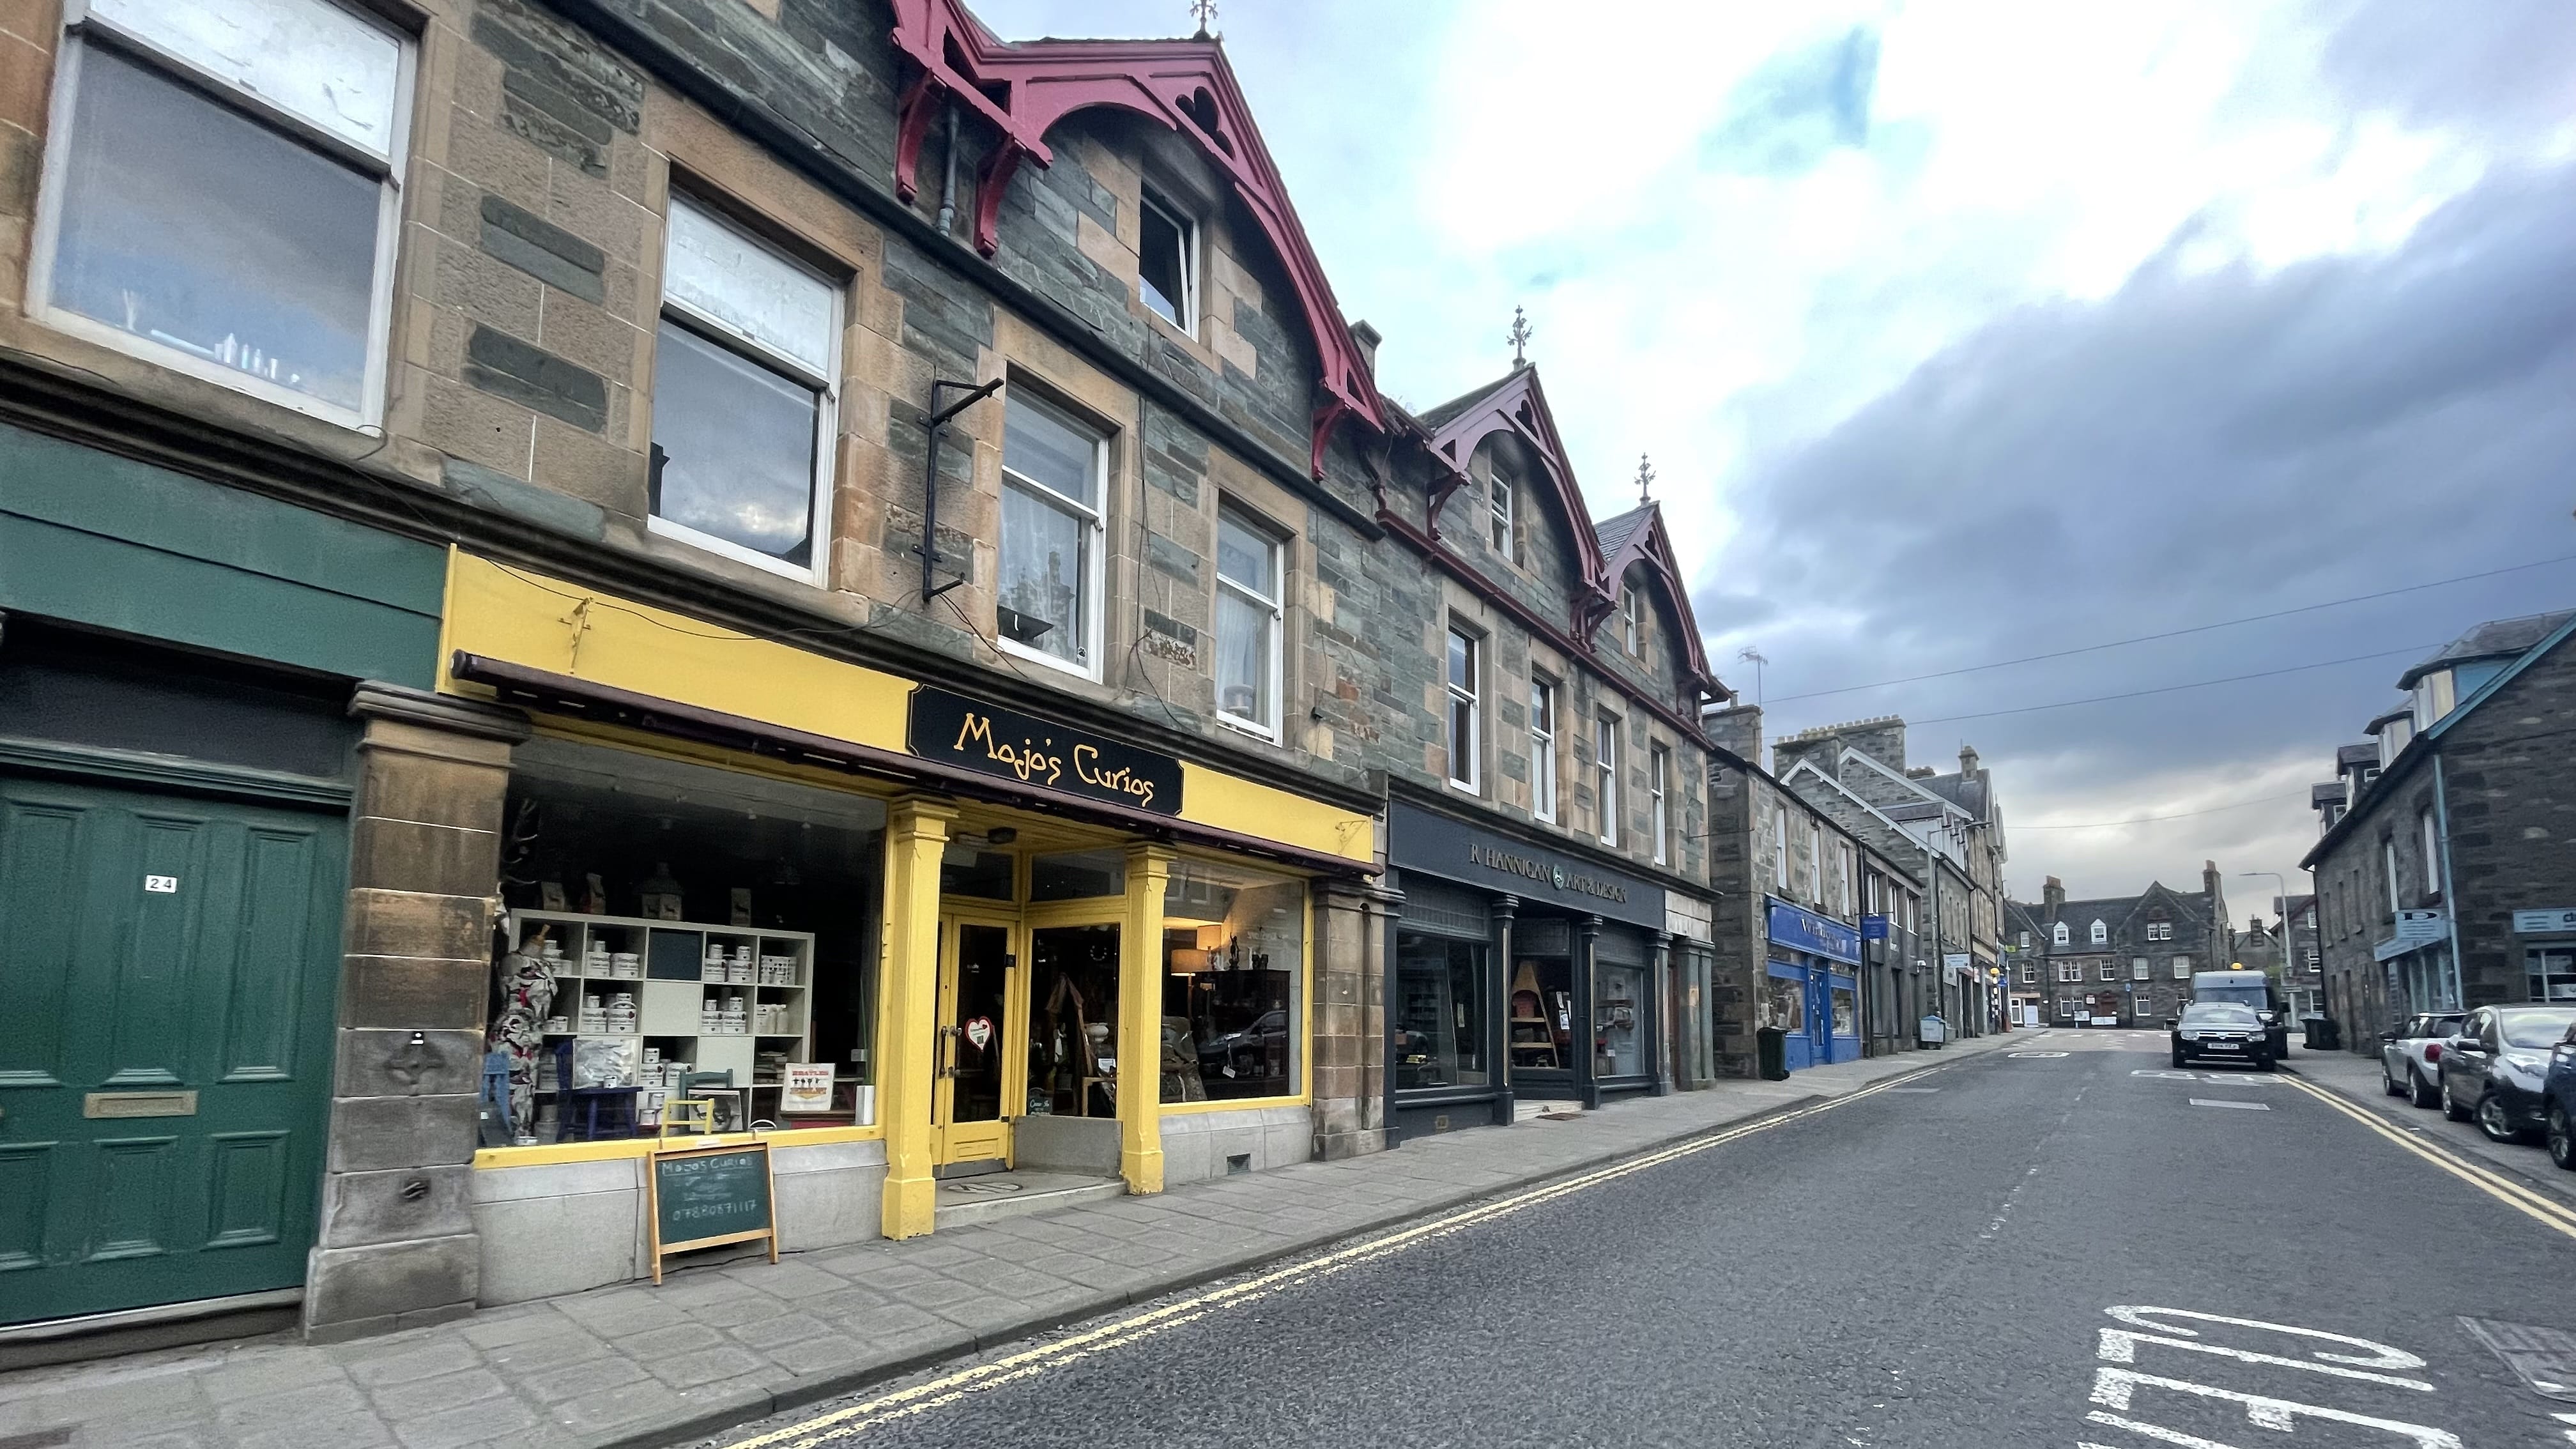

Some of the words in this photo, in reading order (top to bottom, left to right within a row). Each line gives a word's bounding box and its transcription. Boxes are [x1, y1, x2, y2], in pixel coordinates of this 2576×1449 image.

[953, 712, 1062, 786] Mojo's
[1073, 744, 1154, 808] Curios
[150, 878, 172, 890] 24
[1470, 843, 1481, 864] R
[1485, 848, 1551, 882] HANNIGAN
[1565, 873, 1586, 893] ART
[1587, 878, 1596, 895] &
[1596, 881, 1626, 903] DESIGN
